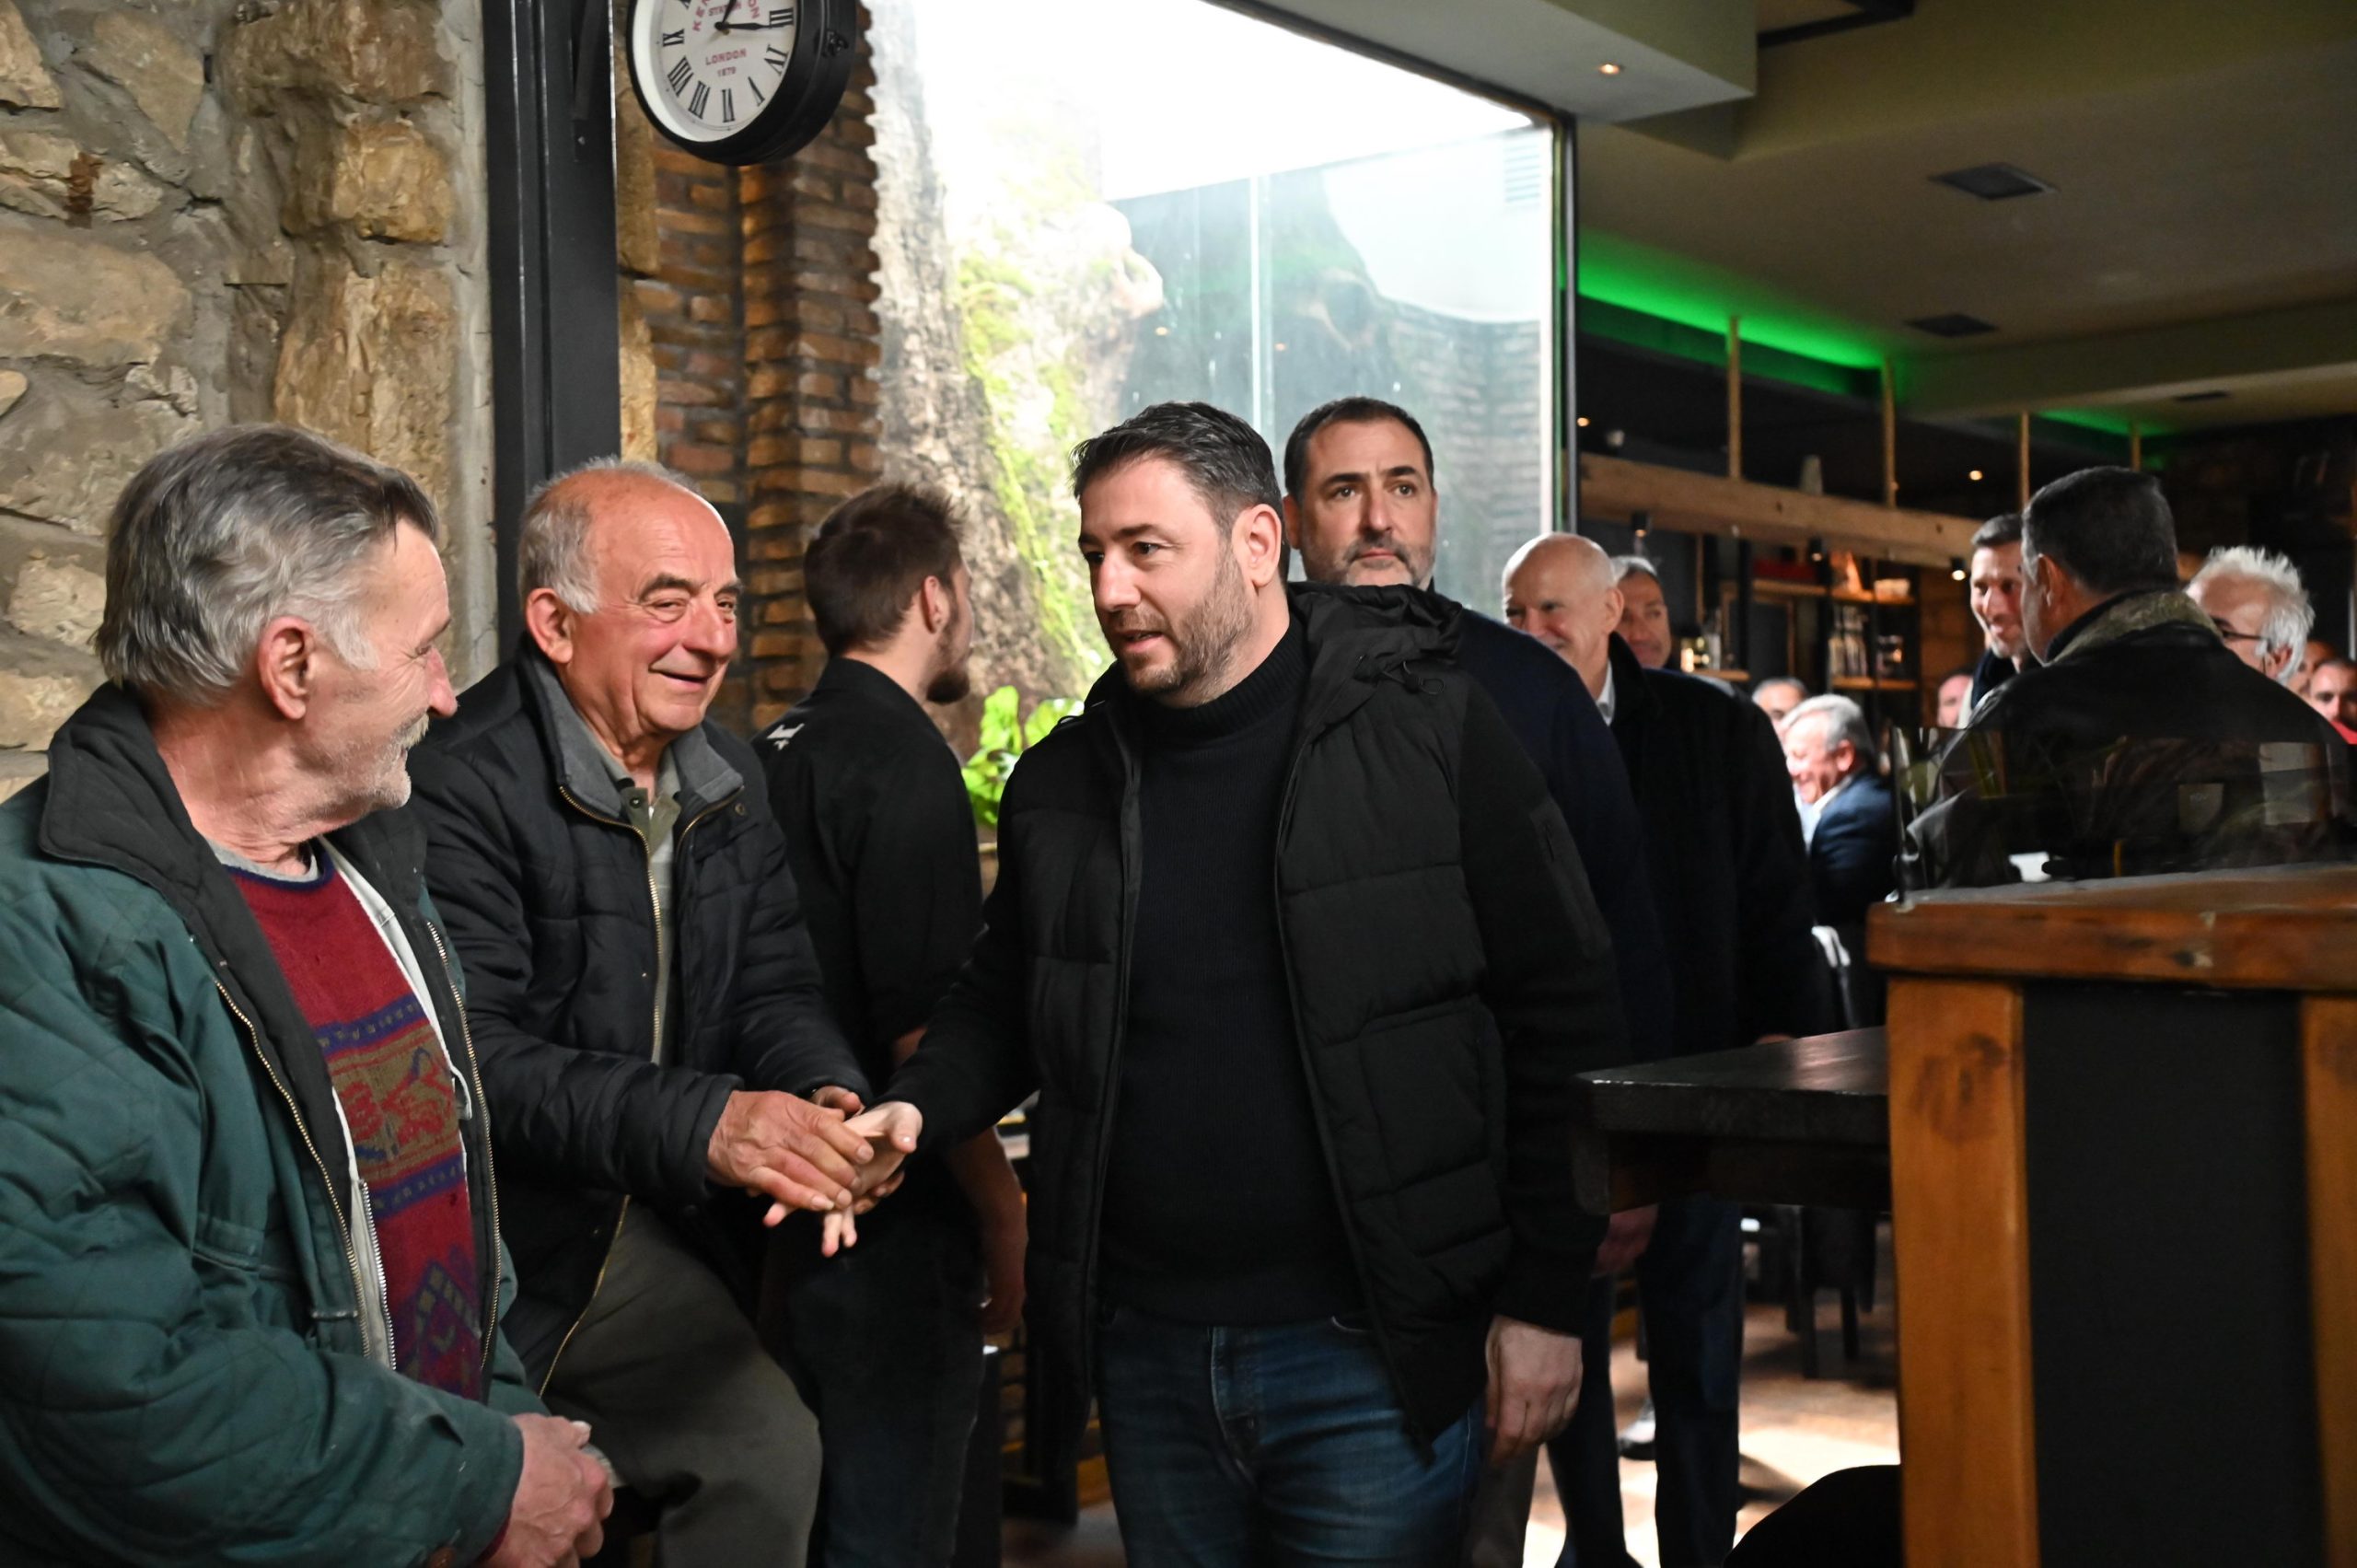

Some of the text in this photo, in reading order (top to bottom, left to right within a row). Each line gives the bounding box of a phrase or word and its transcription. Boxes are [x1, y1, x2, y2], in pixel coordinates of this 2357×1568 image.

[662, 29, 684, 47] IX
[705, 48, 747, 65] LONDON
[667, 55, 694, 99] VIII
[688, 80, 711, 120] VII
[722, 87, 735, 123] VI
